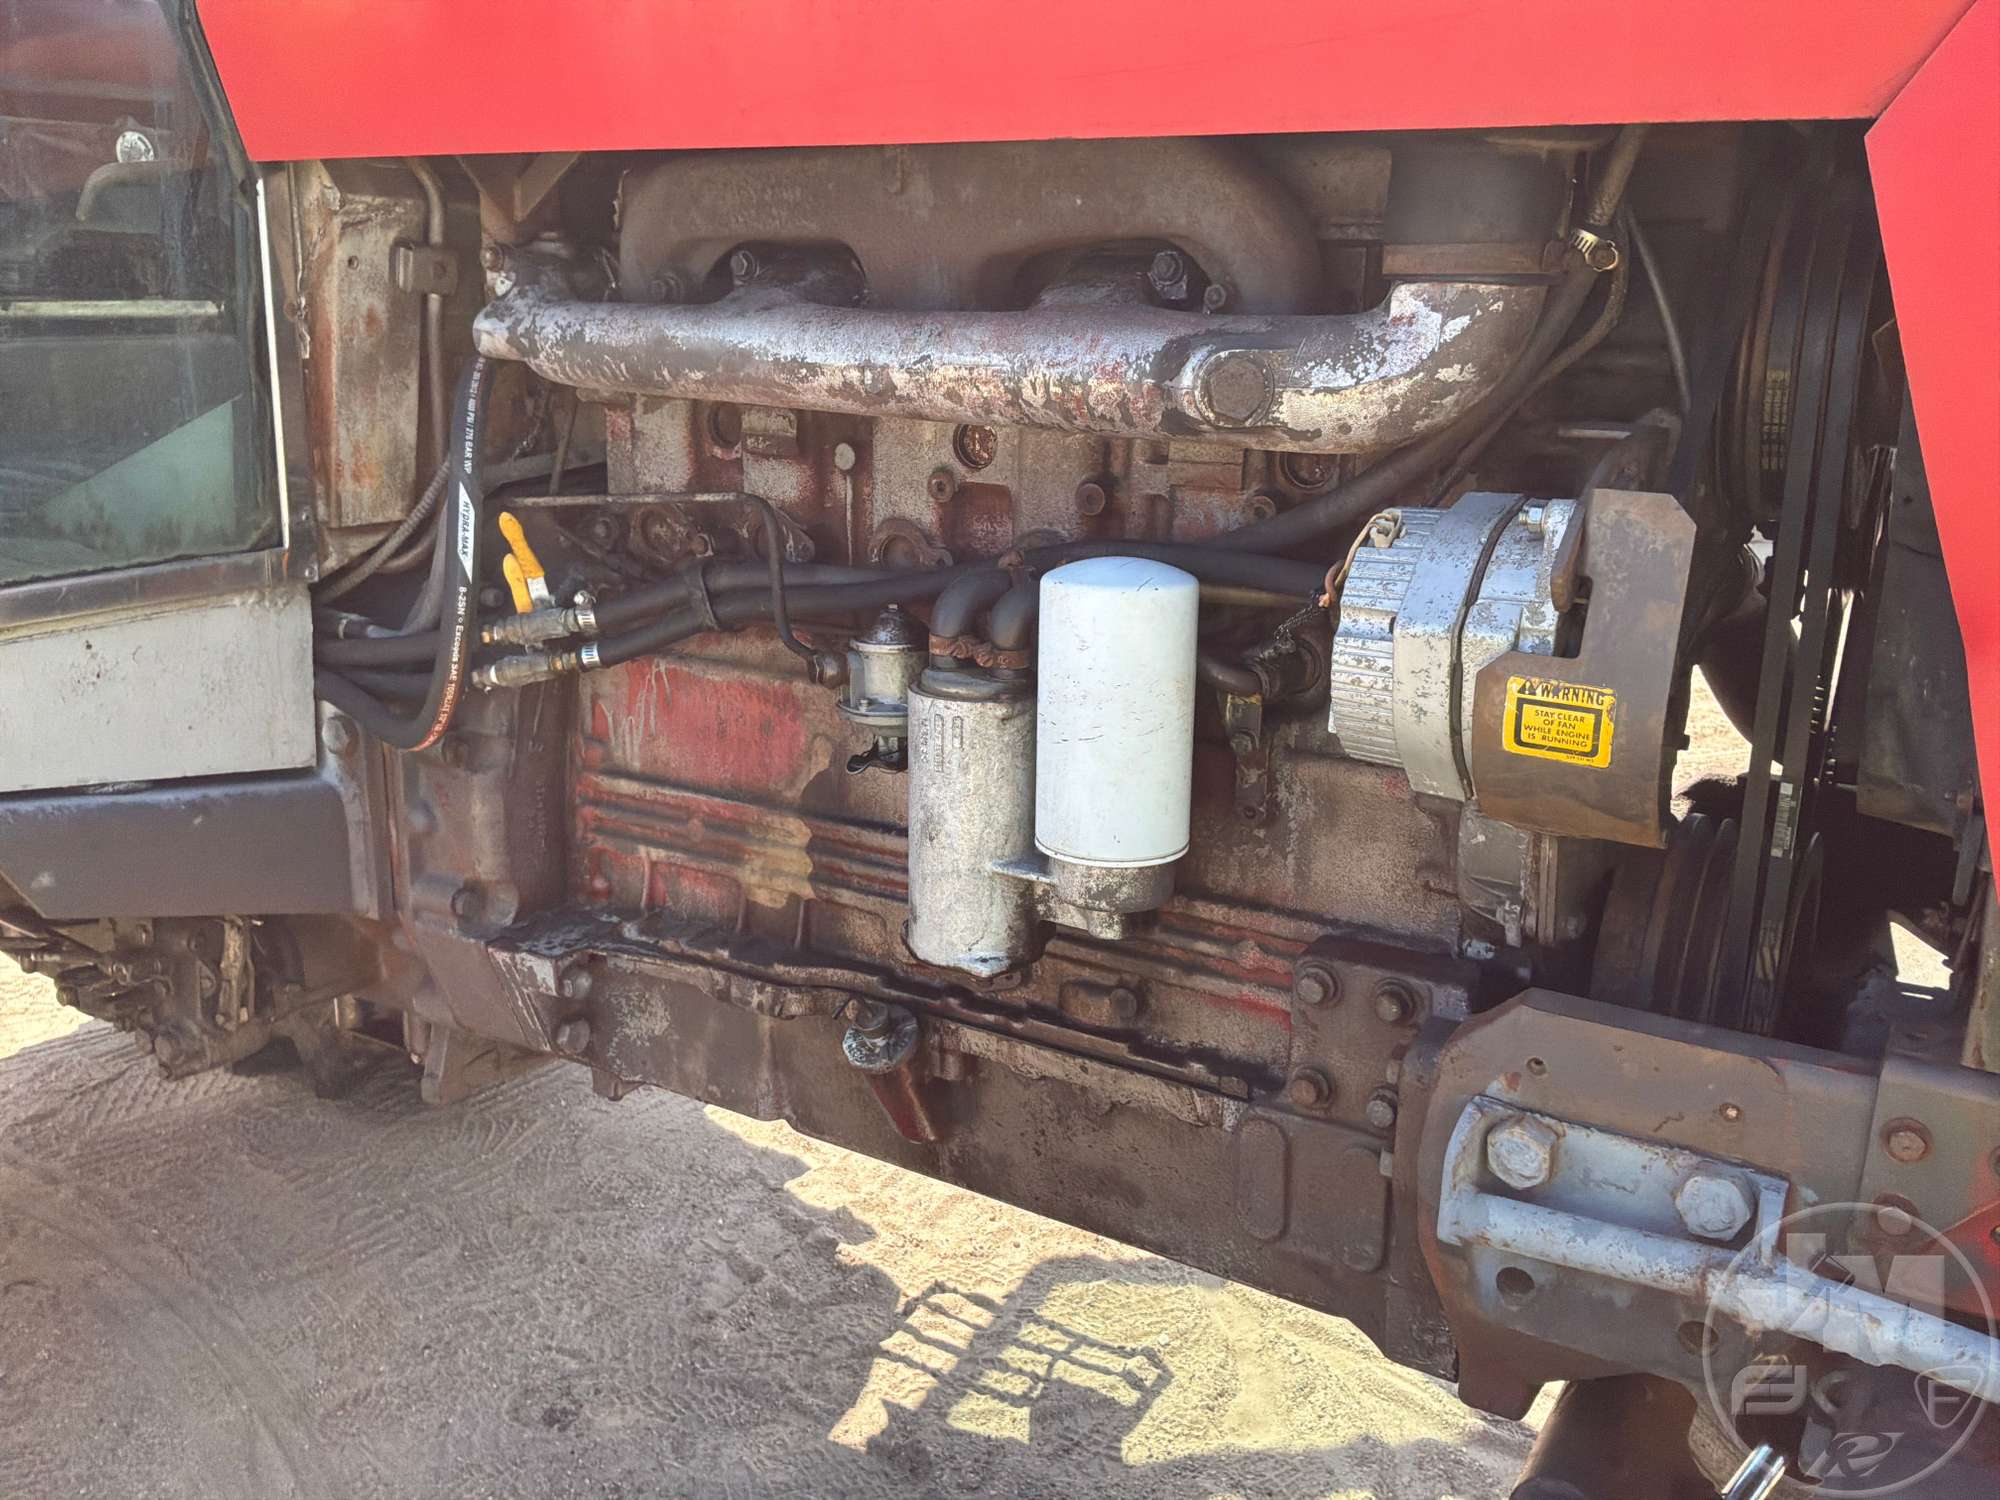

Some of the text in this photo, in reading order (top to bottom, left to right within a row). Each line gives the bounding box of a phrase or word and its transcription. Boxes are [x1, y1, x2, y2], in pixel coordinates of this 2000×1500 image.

[464, 441, 473, 458] BAR
[463, 459, 472, 474] WP
[461, 500, 471, 557] HYDRA-MAX
[457, 586, 467, 615] 8-2SN
[452, 624, 464, 662] Exceeds
[449, 663, 459, 681] SAE
[1535, 710, 1585, 723] STAY CLEAR
[1543, 718, 1576, 730] OF FAN
[1524, 725, 1589, 740] WHILE ENGINE
[1527, 732, 1587, 747] IS RUNNING
